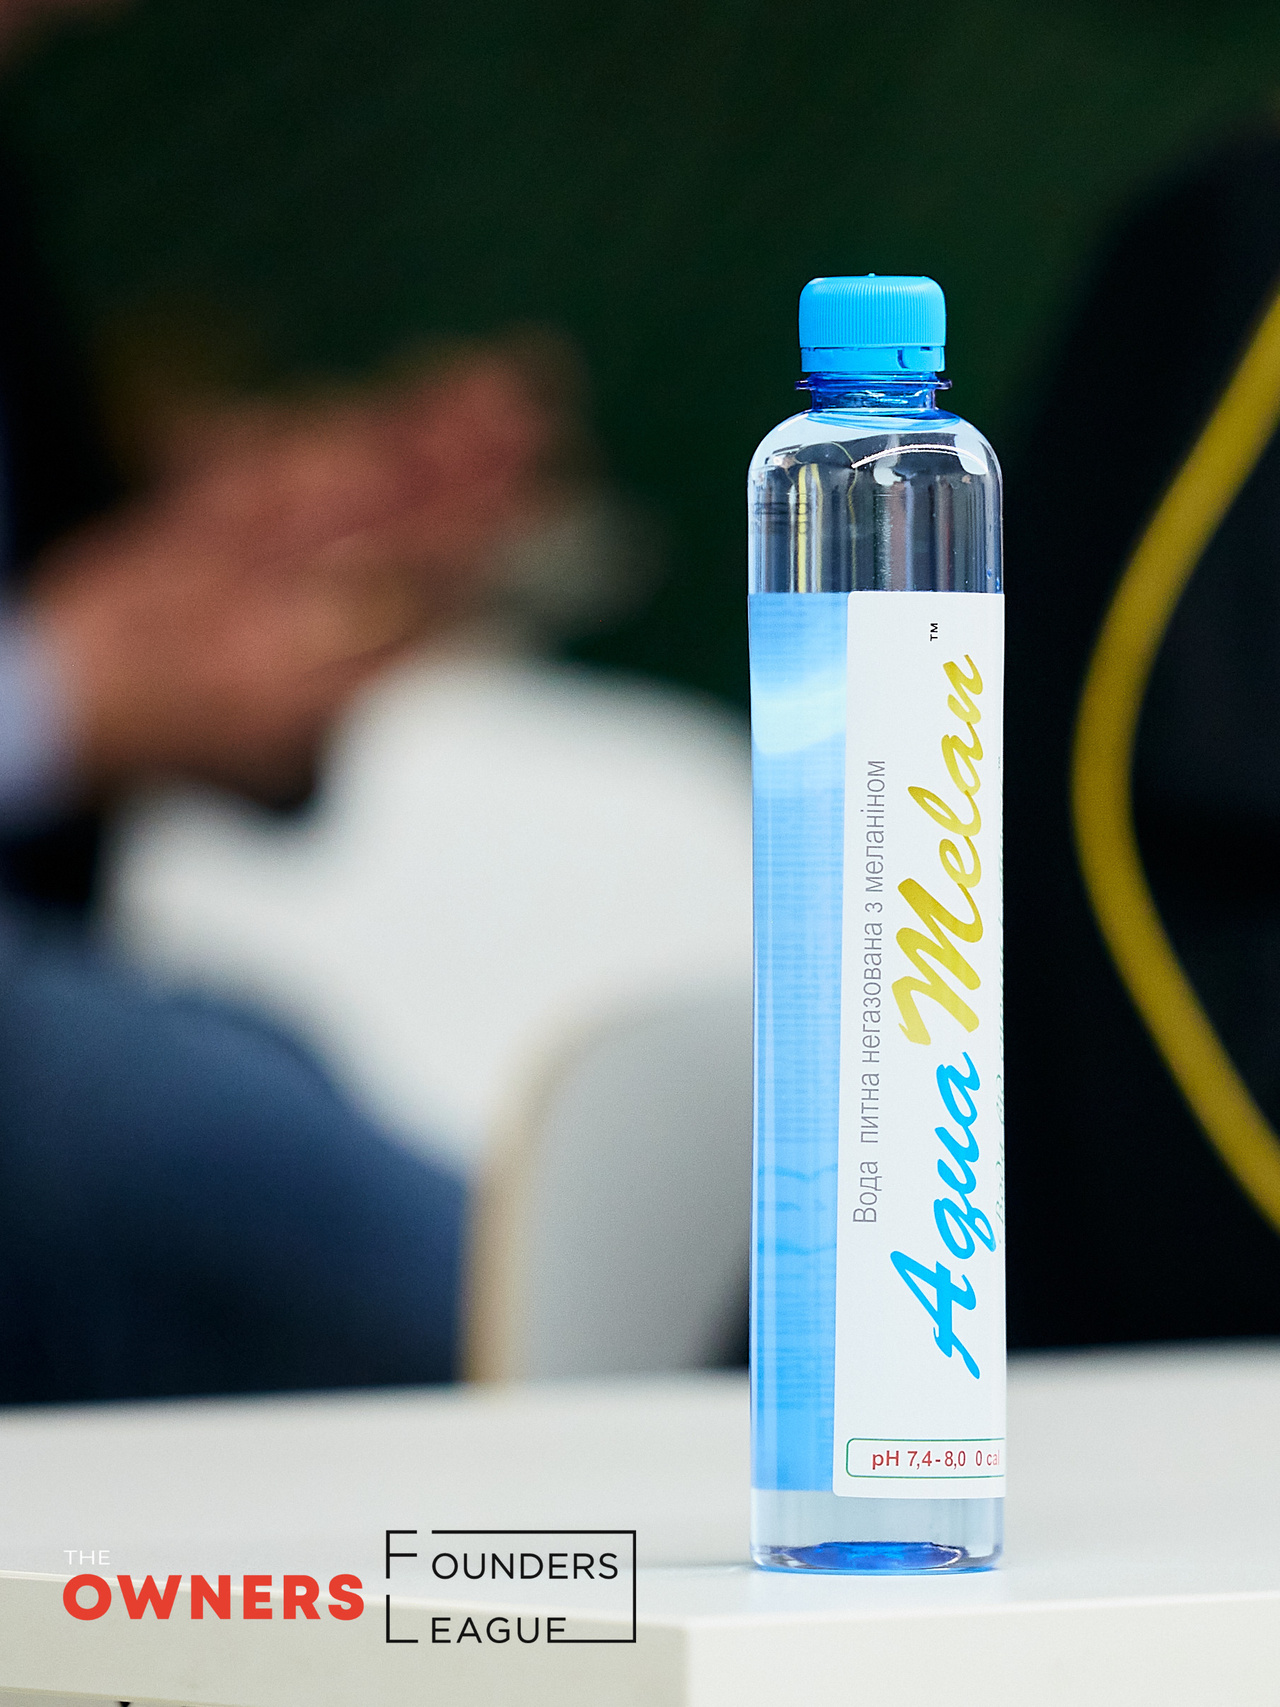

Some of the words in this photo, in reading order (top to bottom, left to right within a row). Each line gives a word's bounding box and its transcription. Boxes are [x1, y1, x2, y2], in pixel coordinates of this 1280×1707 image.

[860, 759, 886, 893] меланіном
[891, 654, 984, 1045] Melan
[864, 901, 884, 914] з
[861, 921, 883, 1064] негазована
[860, 1073, 880, 1144] питна
[852, 1160, 883, 1224] Вода
[889, 1051, 998, 1381] Aqua
[871, 1449, 900, 1471] pH
[975, 1449, 984, 1467] 0
